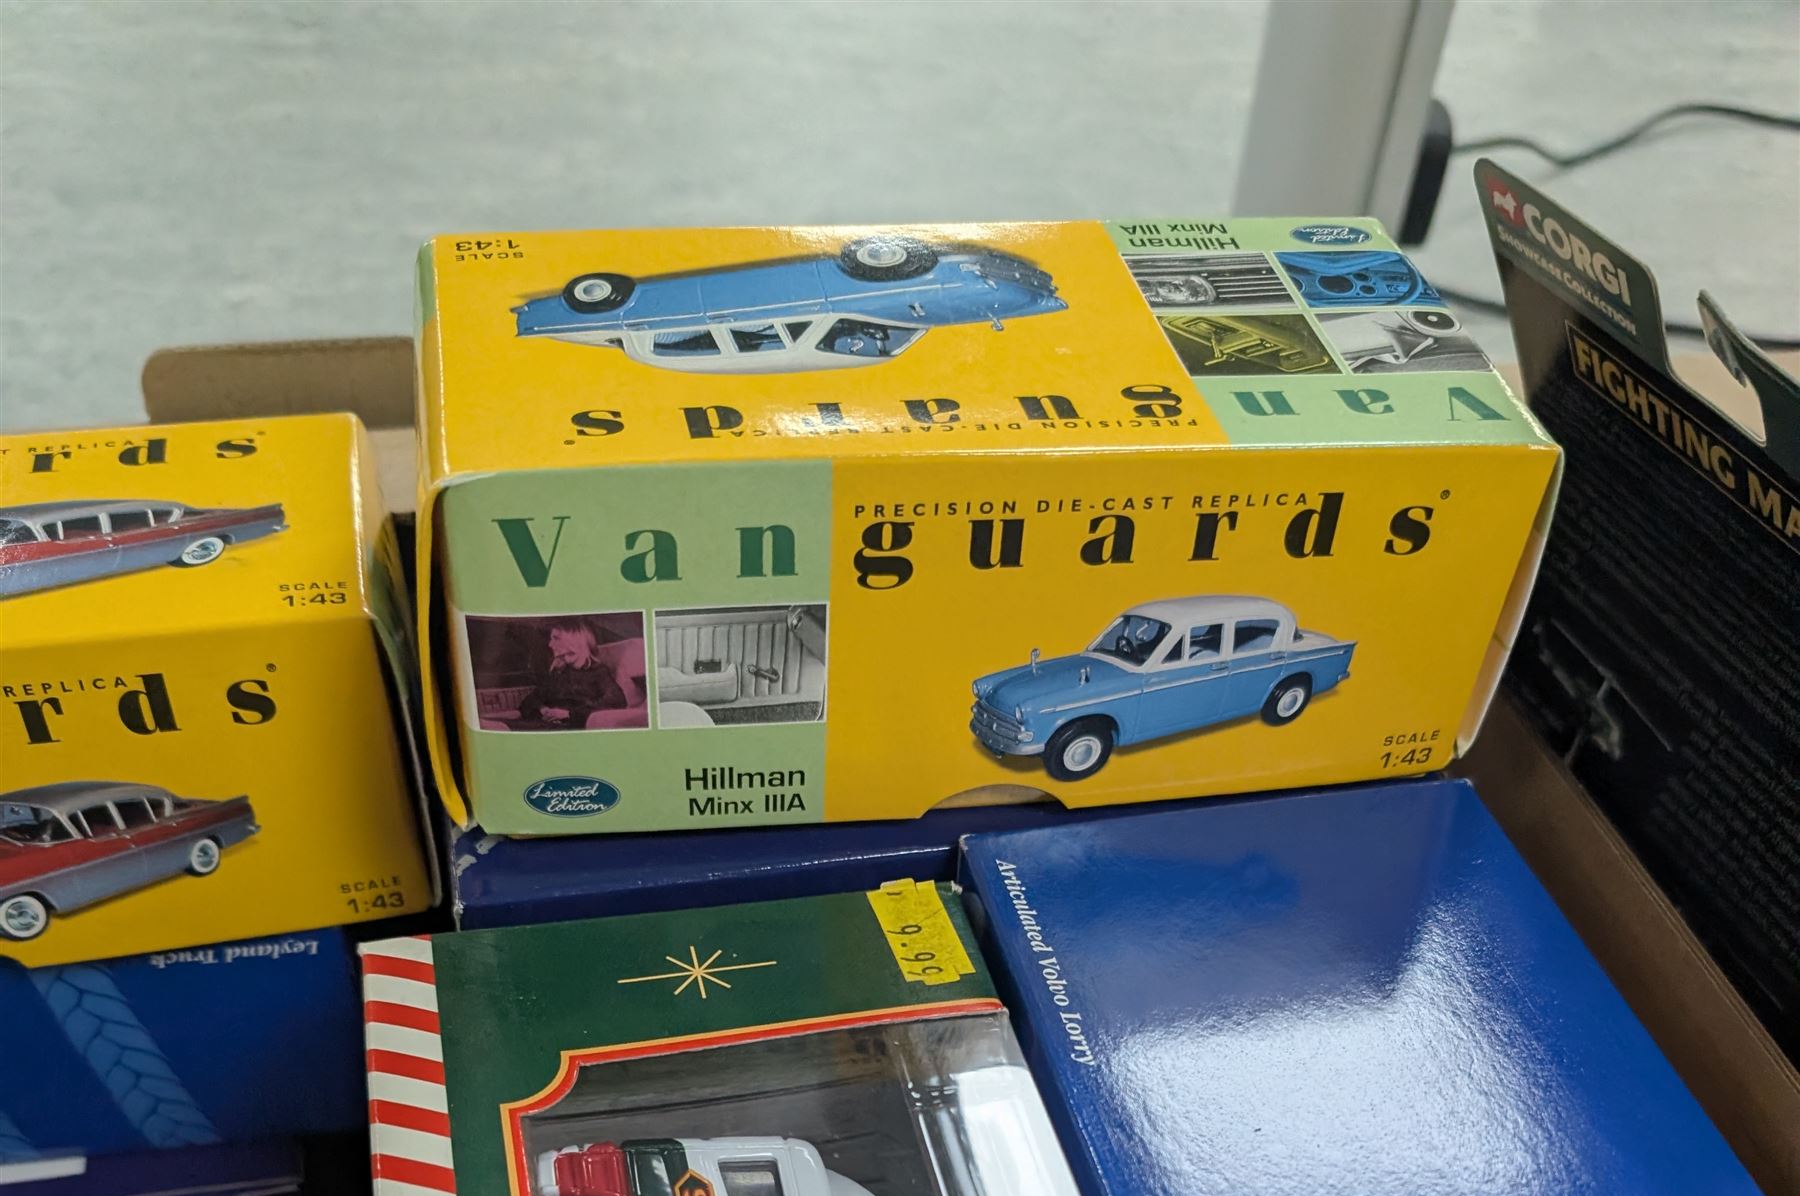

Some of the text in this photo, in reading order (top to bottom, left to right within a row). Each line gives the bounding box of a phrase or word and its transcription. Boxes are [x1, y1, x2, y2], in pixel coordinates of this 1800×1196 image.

[1119, 223, 1229, 236] Minx IIIA
[455, 239, 520, 252] 1:43
[1130, 237, 1241, 250] Hillman
[455, 252, 524, 262] SCALE
[1522, 203, 1632, 307] CORGI
[1573, 335, 1736, 490] FIGHTING
[880, 422, 1023, 434] DIE-CAST
[1040, 417, 1199, 430] PRECISION
[27, 439, 134, 454] REPLICA
[853, 492, 1310, 519] PRECISION DIE-CAST REPLICA
[278, 580, 349, 593] SCALE
[280, 591, 348, 608] 1:43
[2, 675, 129, 699] REPLICA
[1383, 729, 1441, 747] SCALE
[1380, 747, 1432, 769] 1:43
[684, 766, 807, 792] Hillman
[530, 782, 599, 800] Limited
[546, 797, 607, 813] Edition
[688, 793, 807, 817] Minx IIIA
[339, 875, 402, 896] SCALE
[345, 890, 406, 917] 1:43
[149, 938, 320, 970] Leyland Truck
[995, 858, 1095, 1067] Articulated Volvo Lorry
